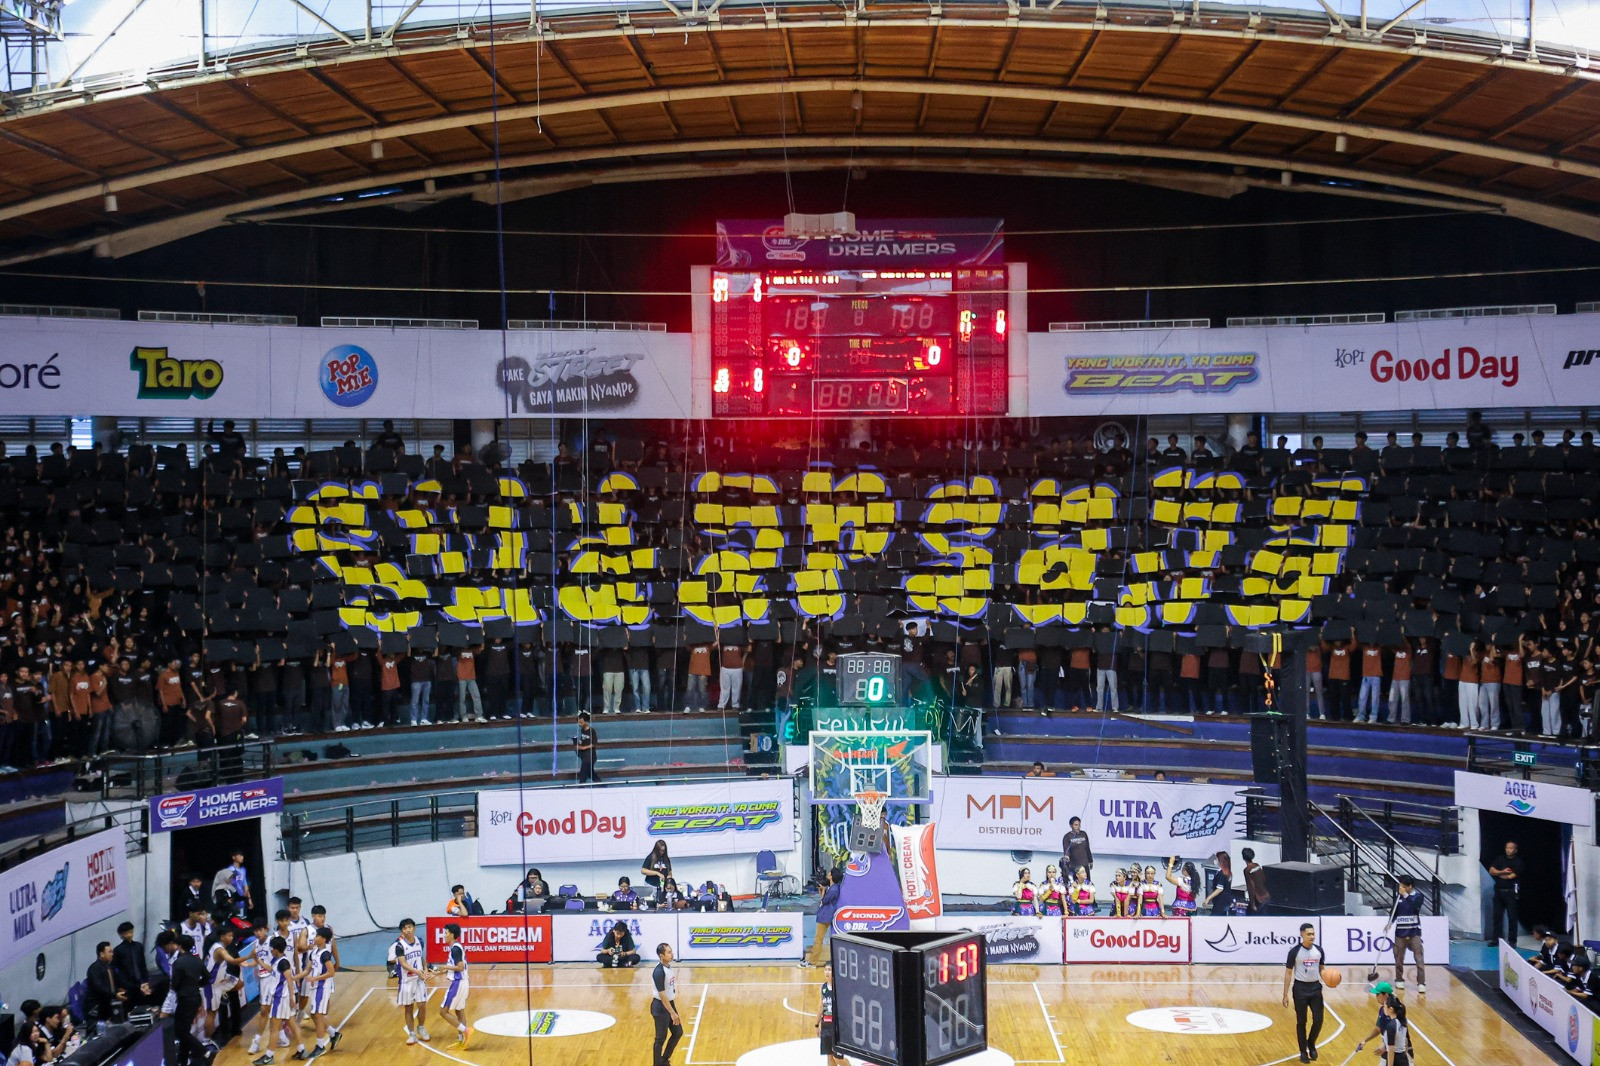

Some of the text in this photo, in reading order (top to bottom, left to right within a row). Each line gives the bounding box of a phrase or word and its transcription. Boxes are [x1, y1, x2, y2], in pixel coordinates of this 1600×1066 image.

[828, 242, 957, 257] DREAMERS
[136, 346, 224, 392] Taro
[327, 354, 360, 382] POP
[1068, 358, 1108, 369] YANG
[1112, 357, 1168, 369] WORTH
[1191, 356, 1211, 368] YA
[1213, 355, 1255, 366] CUMA
[1370, 348, 1451, 383] Good
[1458, 347, 1519, 387] Day
[336, 366, 372, 395] MIE
[502, 368, 524, 382] PAKE
[530, 389, 553, 406] GAYA
[556, 386, 588, 402] MAKIN
[1514, 753, 1535, 763] EXIT
[199, 791, 241, 808] HOME
[1504, 781, 1537, 800] AQUA
[199, 797, 278, 818] DREAMERS
[649, 808, 678, 817] YANG
[680, 805, 717, 815] WORTH
[734, 804, 748, 812] YA
[749, 802, 778, 811] CUMA
[1099, 799, 1163, 819] ULTRA
[516, 811, 576, 837] Good
[581, 809, 626, 839] Day
[979, 826, 1042, 836] DISTRIBUTOR
[1106, 820, 1156, 840] MILK
[903, 836, 913, 869] CREAM
[87, 850, 105, 878] HOT
[88, 870, 116, 899] CREAM
[906, 880, 917, 898] HOT
[9, 882, 37, 914] ULTRA
[13, 909, 35, 942] MILK
[435, 927, 543, 944] HT IN CREAM
[851, 922, 868, 931] DBL
[498, 944, 535, 952] PEMANASAN
[989, 944, 1009, 955] MAKIN
[1090, 929, 1140, 948] Good
[1143, 930, 1180, 953] Day
